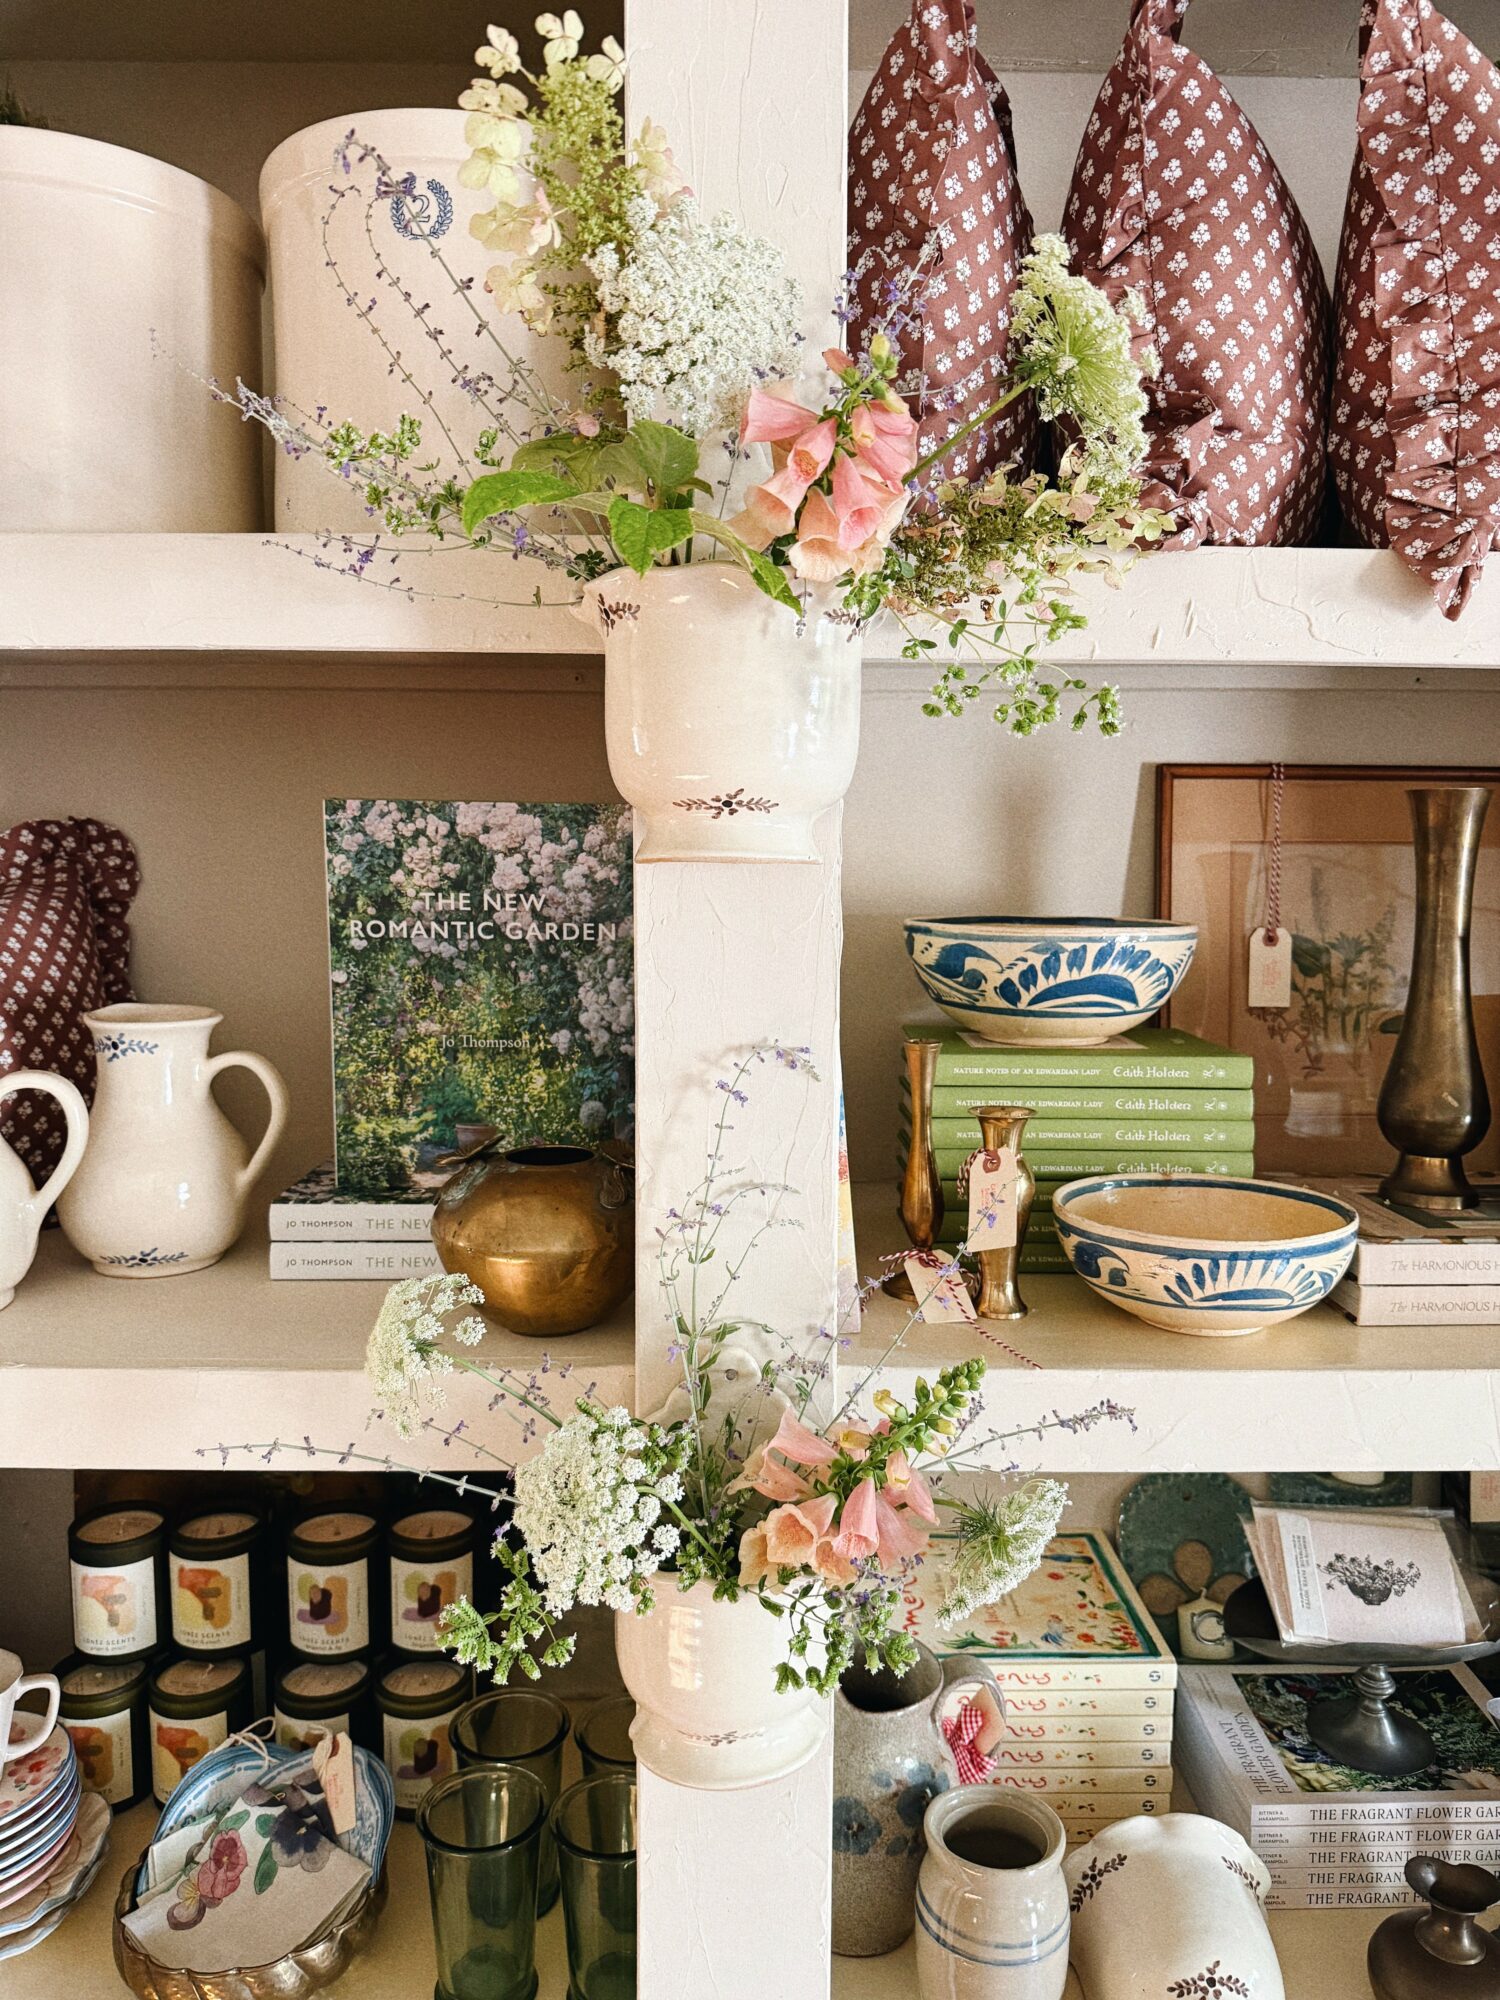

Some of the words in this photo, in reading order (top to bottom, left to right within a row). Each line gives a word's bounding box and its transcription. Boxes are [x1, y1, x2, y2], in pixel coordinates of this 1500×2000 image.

[420, 892, 472, 912] THE
[483, 892, 546, 912] NEW
[349, 919, 495, 941] ROMANTIC
[505, 922, 618, 942] GARDEN
[439, 1034, 455, 1052] Jo
[461, 1034, 531, 1052] Thompson
[953, 1067, 984, 1075] NATURE
[985, 1067, 1009, 1075] NOTES
[1011, 1067, 1021, 1075] OF
[1023, 1067, 1034, 1075] AN
[1036, 1068, 1079, 1076] EDWARDIAN
[1081, 1068, 1102, 1076] LADY
[1113, 1066, 1143, 1078] Edith
[1146, 1066, 1190, 1078] Holden
[956, 1099, 985, 1107] NATURE
[988, 1099, 1011, 1107] NOTES
[1038, 1100, 1082, 1108] EDWARDIAN
[1084, 1100, 1104, 1108] LADY
[1115, 1098, 1146, 1111] Edith
[1148, 1098, 1191, 1111] Holden
[1115, 1129, 1146, 1142] Edith
[1148, 1129, 1191, 1142] Holden
[1117, 1162, 1148, 1174] Edith
[1150, 1162, 1193, 1174] Holden
[286, 1220, 297, 1229] JO
[301, 1220, 353, 1228] THOMPSON
[366, 1218, 395, 1230] THE
[286, 1258, 297, 1267] JO
[301, 1258, 353, 1267] THOMPSON
[366, 1256, 395, 1268] THE
[401, 1256, 438, 1268] NEW
[1391, 1260, 1408, 1271] The
[1412, 1260, 1492, 1271] HARMONIOUS
[1389, 1302, 1407, 1313] The
[1410, 1301, 1490, 1312] HARMONIOUS
[996, 1672, 1051, 1685] enus
[1310, 1809, 1336, 1821] THE
[1341, 1808, 1413, 1821] FRAGRANT
[1416, 1807, 1472, 1819] FLOWER
[1310, 1831, 1336, 1843] THE
[1341, 1830, 1413, 1843] FRAGRANT
[1416, 1829, 1472, 1842] FLOWER
[1309, 1851, 1336, 1863] THE
[1340, 1851, 1412, 1863] FRAGRANT
[1308, 1872, 1334, 1884] THE
[1339, 1871, 1405, 1884] FRAGRAN
[1306, 1893, 1334, 1905] THE
[1338, 1892, 1410, 1904] FRAGRANT
